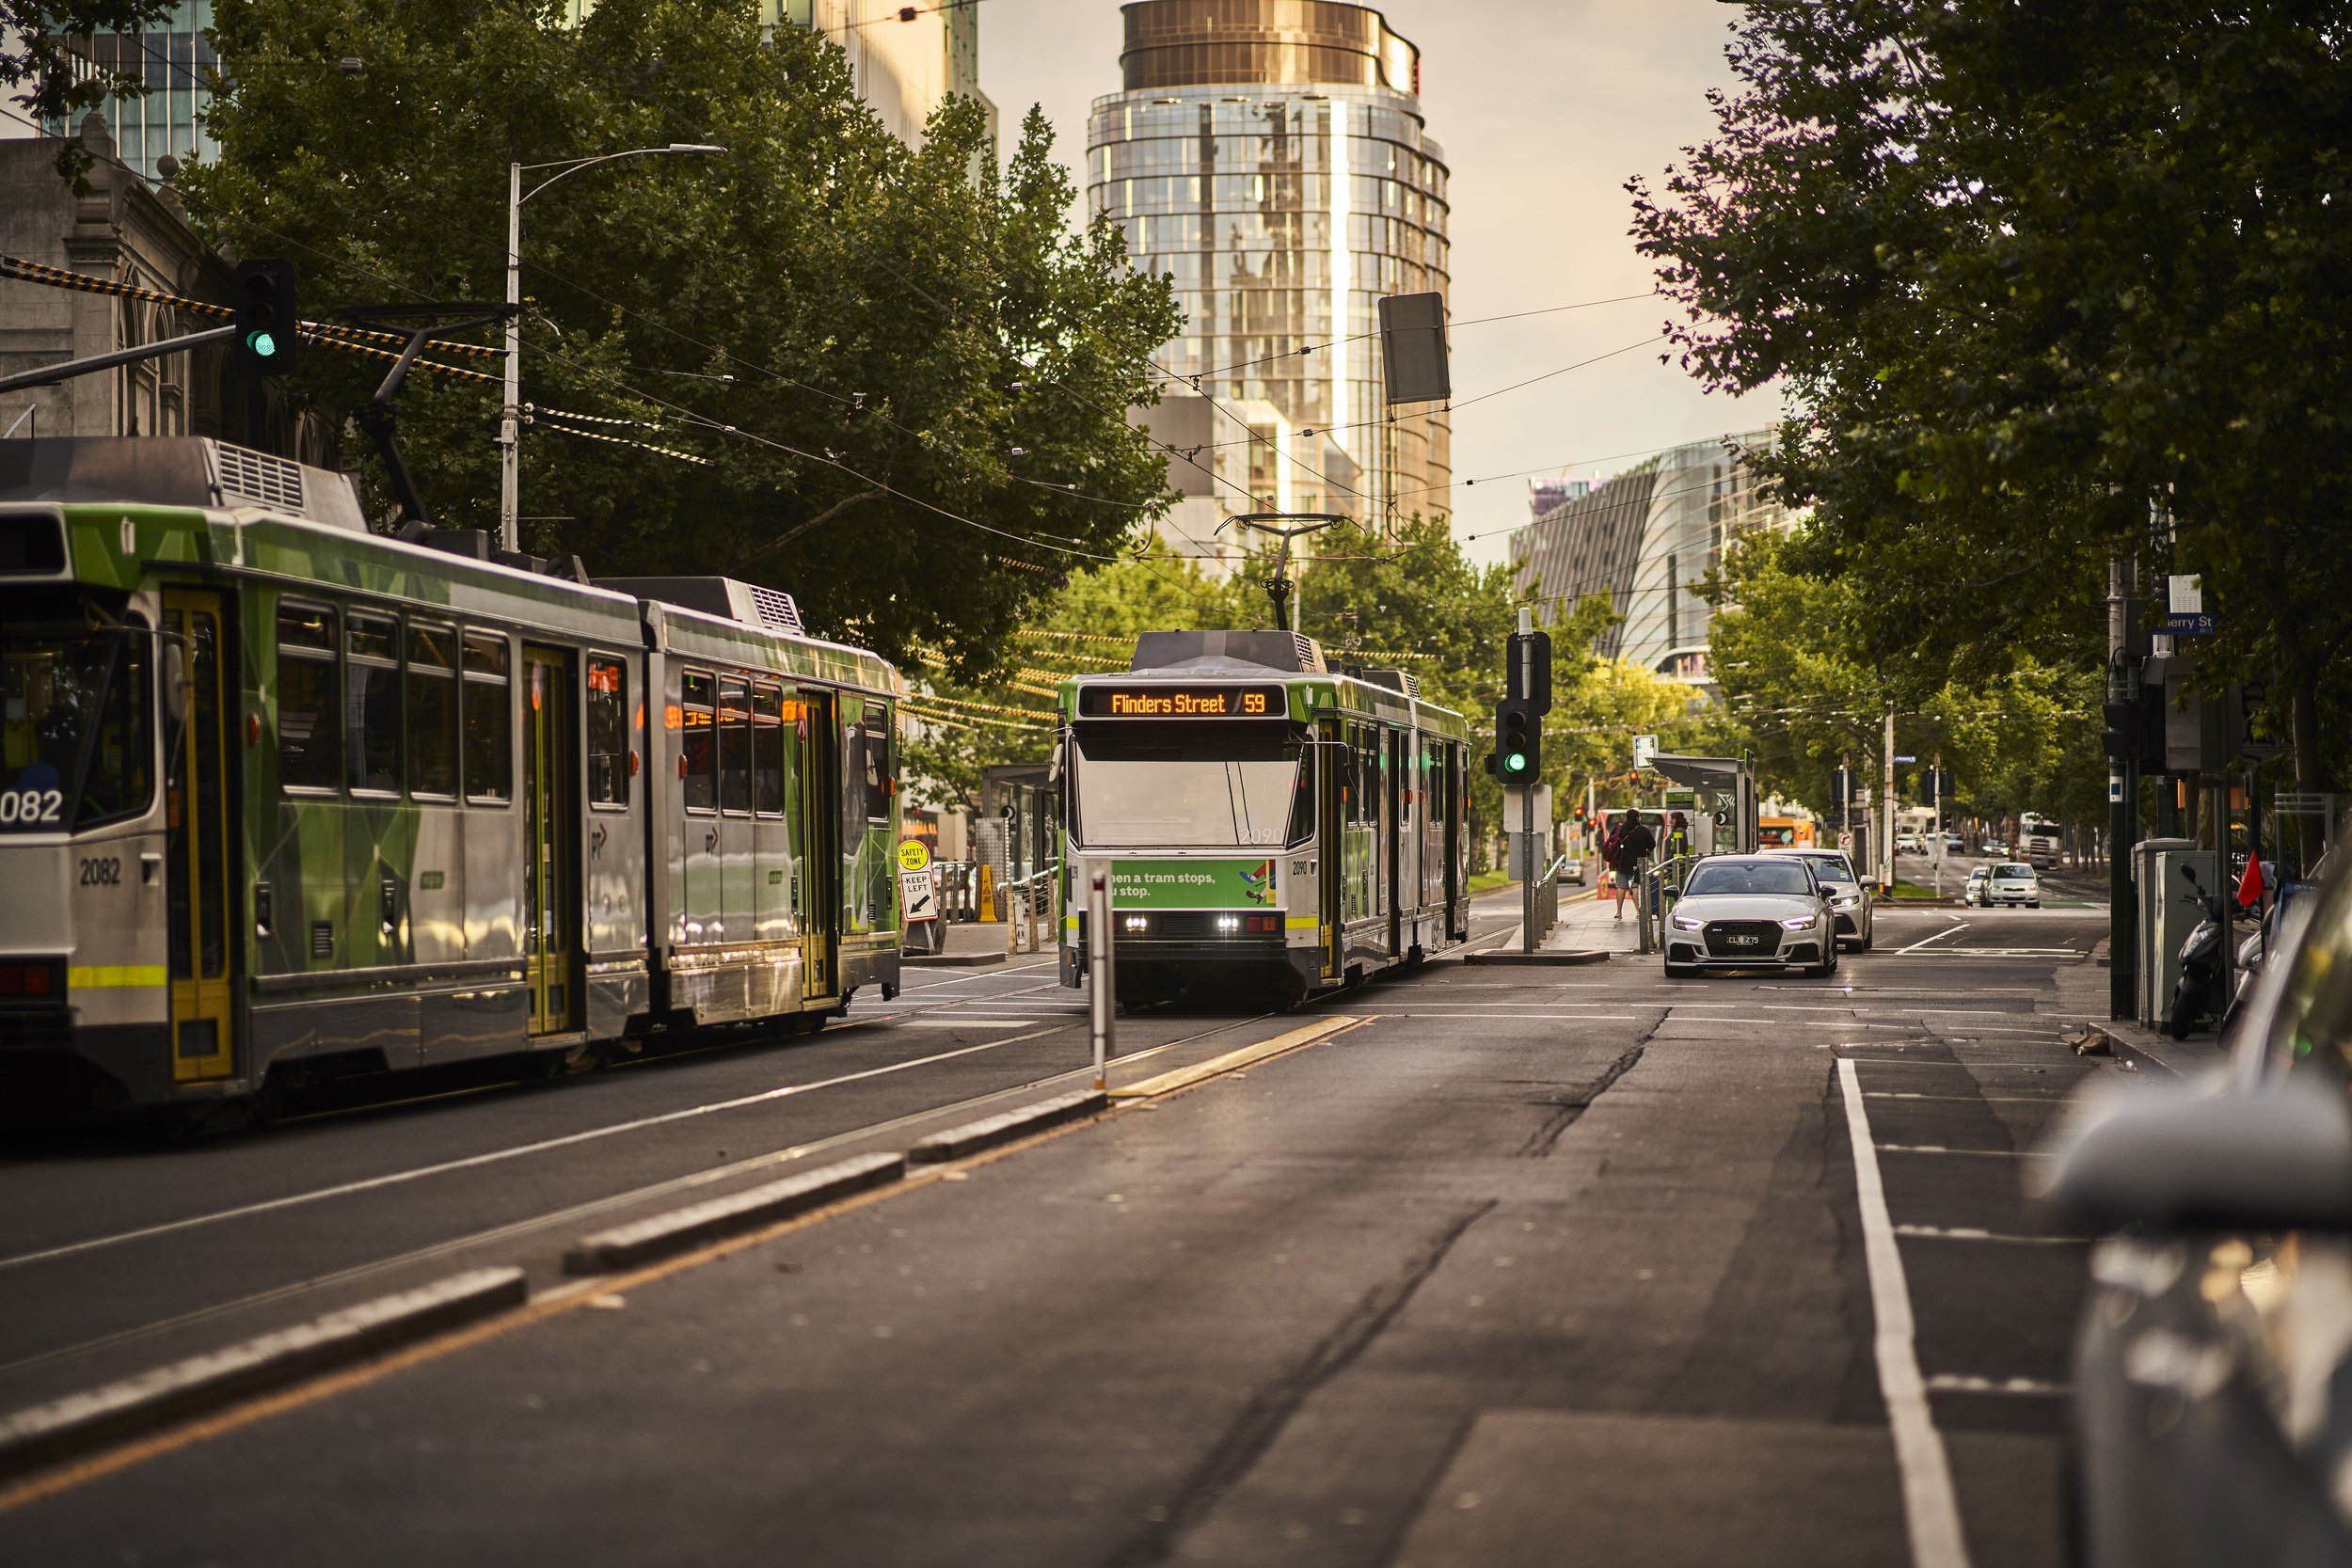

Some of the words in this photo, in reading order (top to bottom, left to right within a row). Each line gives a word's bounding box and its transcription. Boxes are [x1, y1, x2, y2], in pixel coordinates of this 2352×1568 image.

[2199, 616, 2213, 626] St
[1112, 694, 1171, 713] Flinders
[1175, 694, 1226, 713] Street
[1245, 694, 1265, 713] 59
[0, 790, 63, 822] 082
[1241, 829, 1282, 844] 2090
[900, 848, 924, 857] SAFETY
[80, 857, 121, 885] 2082
[1293, 861, 1308, 876] 2090
[906, 876, 927, 884] KEEP
[1134, 875, 1142, 883] a
[1144, 873, 1175, 883] tram
[1178, 873, 1216, 885] stops,
[908, 884, 928, 893] LEFT
[1120, 886, 1151, 898] stop.
